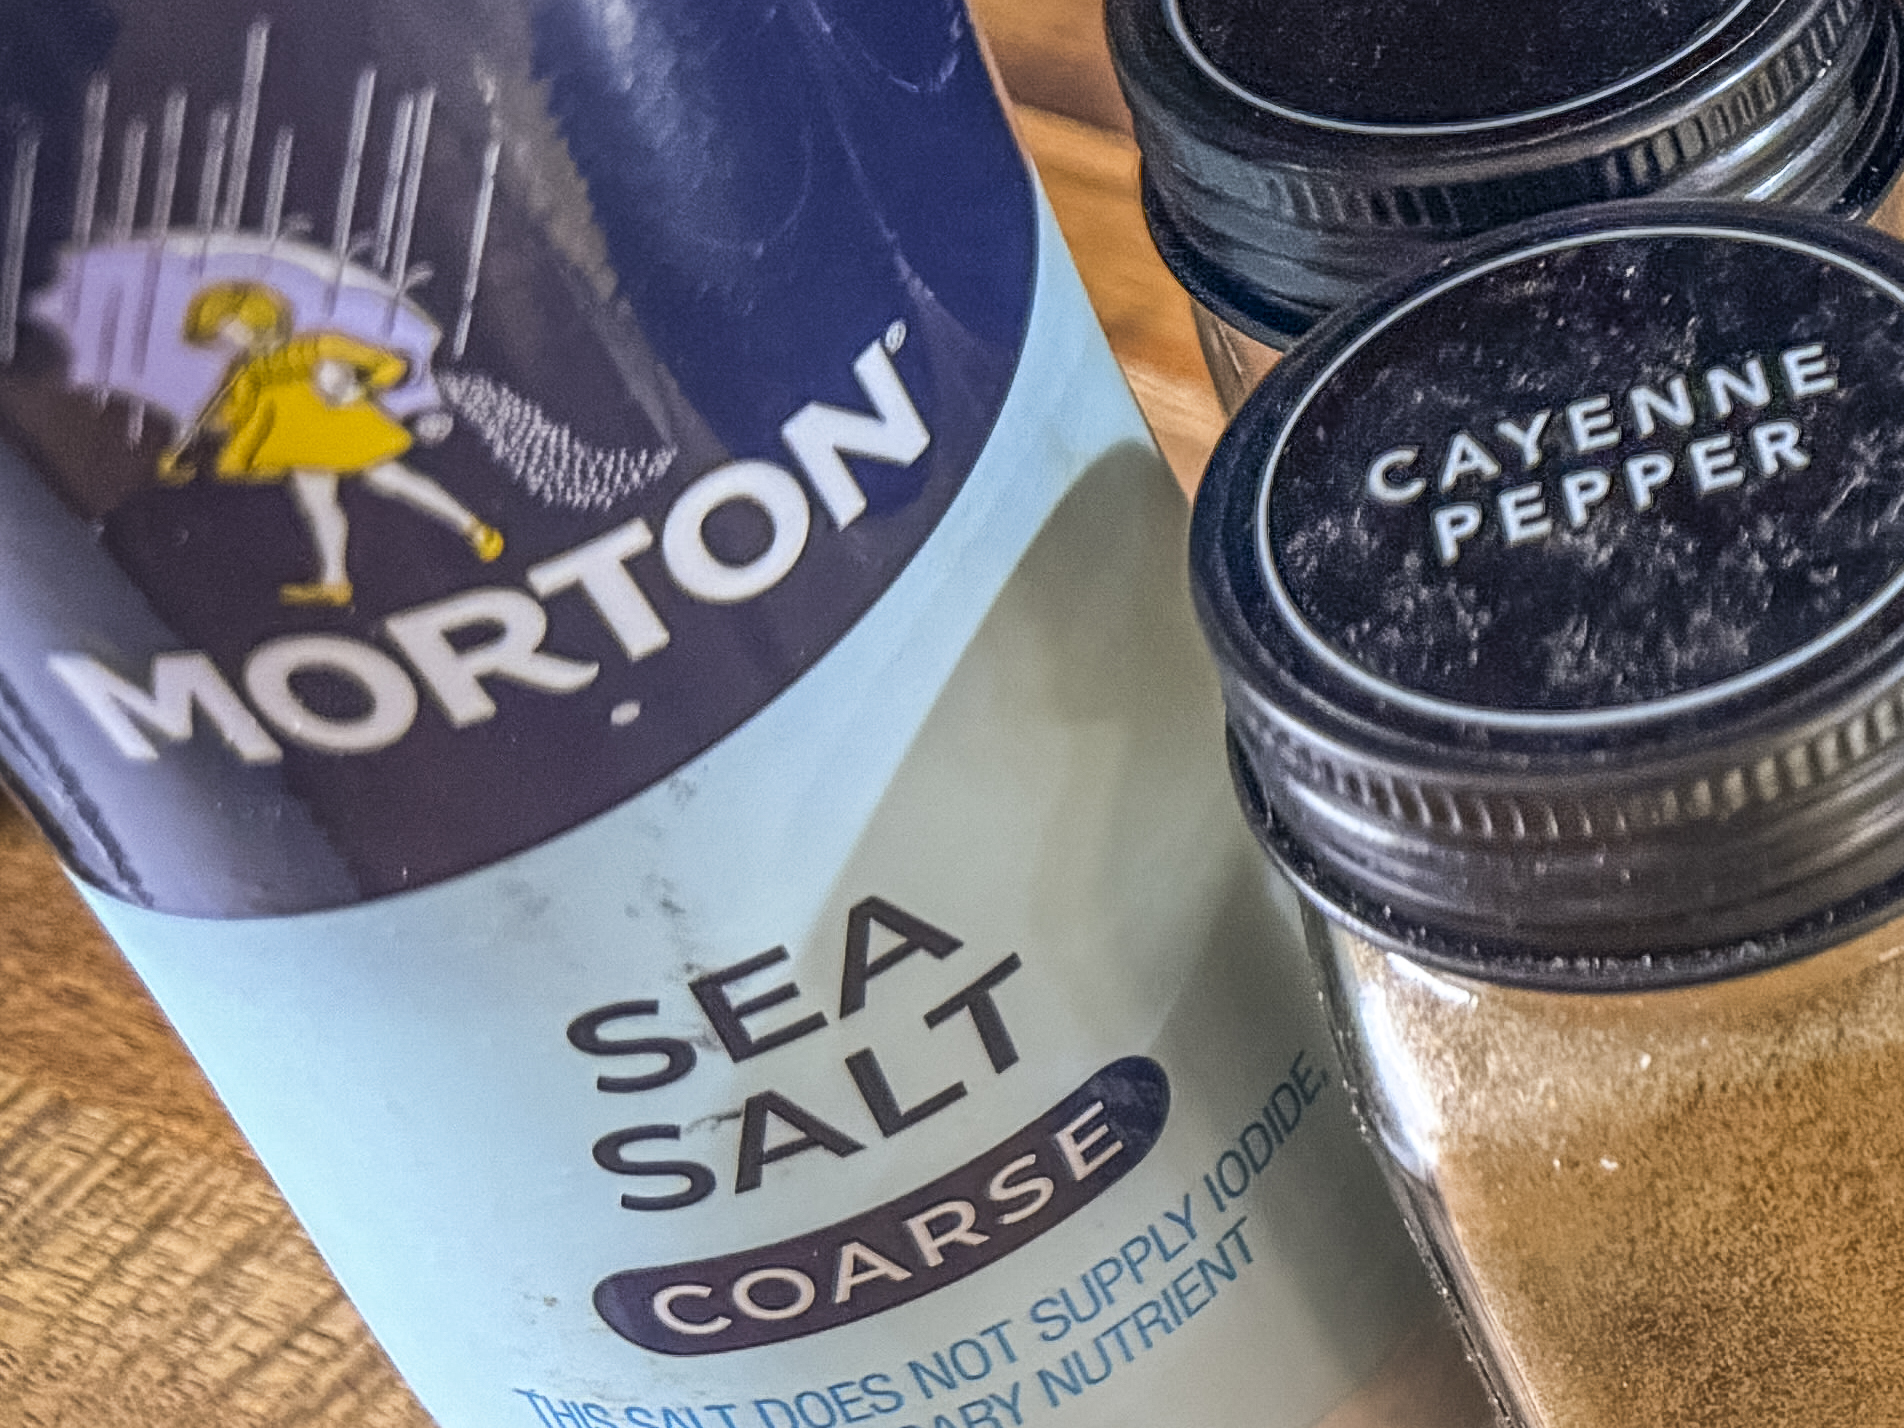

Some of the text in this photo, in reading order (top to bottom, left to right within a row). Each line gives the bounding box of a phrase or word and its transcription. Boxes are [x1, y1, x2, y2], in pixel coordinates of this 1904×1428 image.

[1366, 342, 1839, 504] CAYENNE
[1431, 418, 1811, 565] PEPPER
[565, 894, 965, 1094] SEA
[591, 952, 1023, 1212] SALT
[651, 1101, 1126, 1336] COARSE
[910, 1321, 1017, 1400] NOT
[1028, 1192, 1197, 1344] SUPPLY
[1039, 1215, 1257, 1407] NUTRIENT
